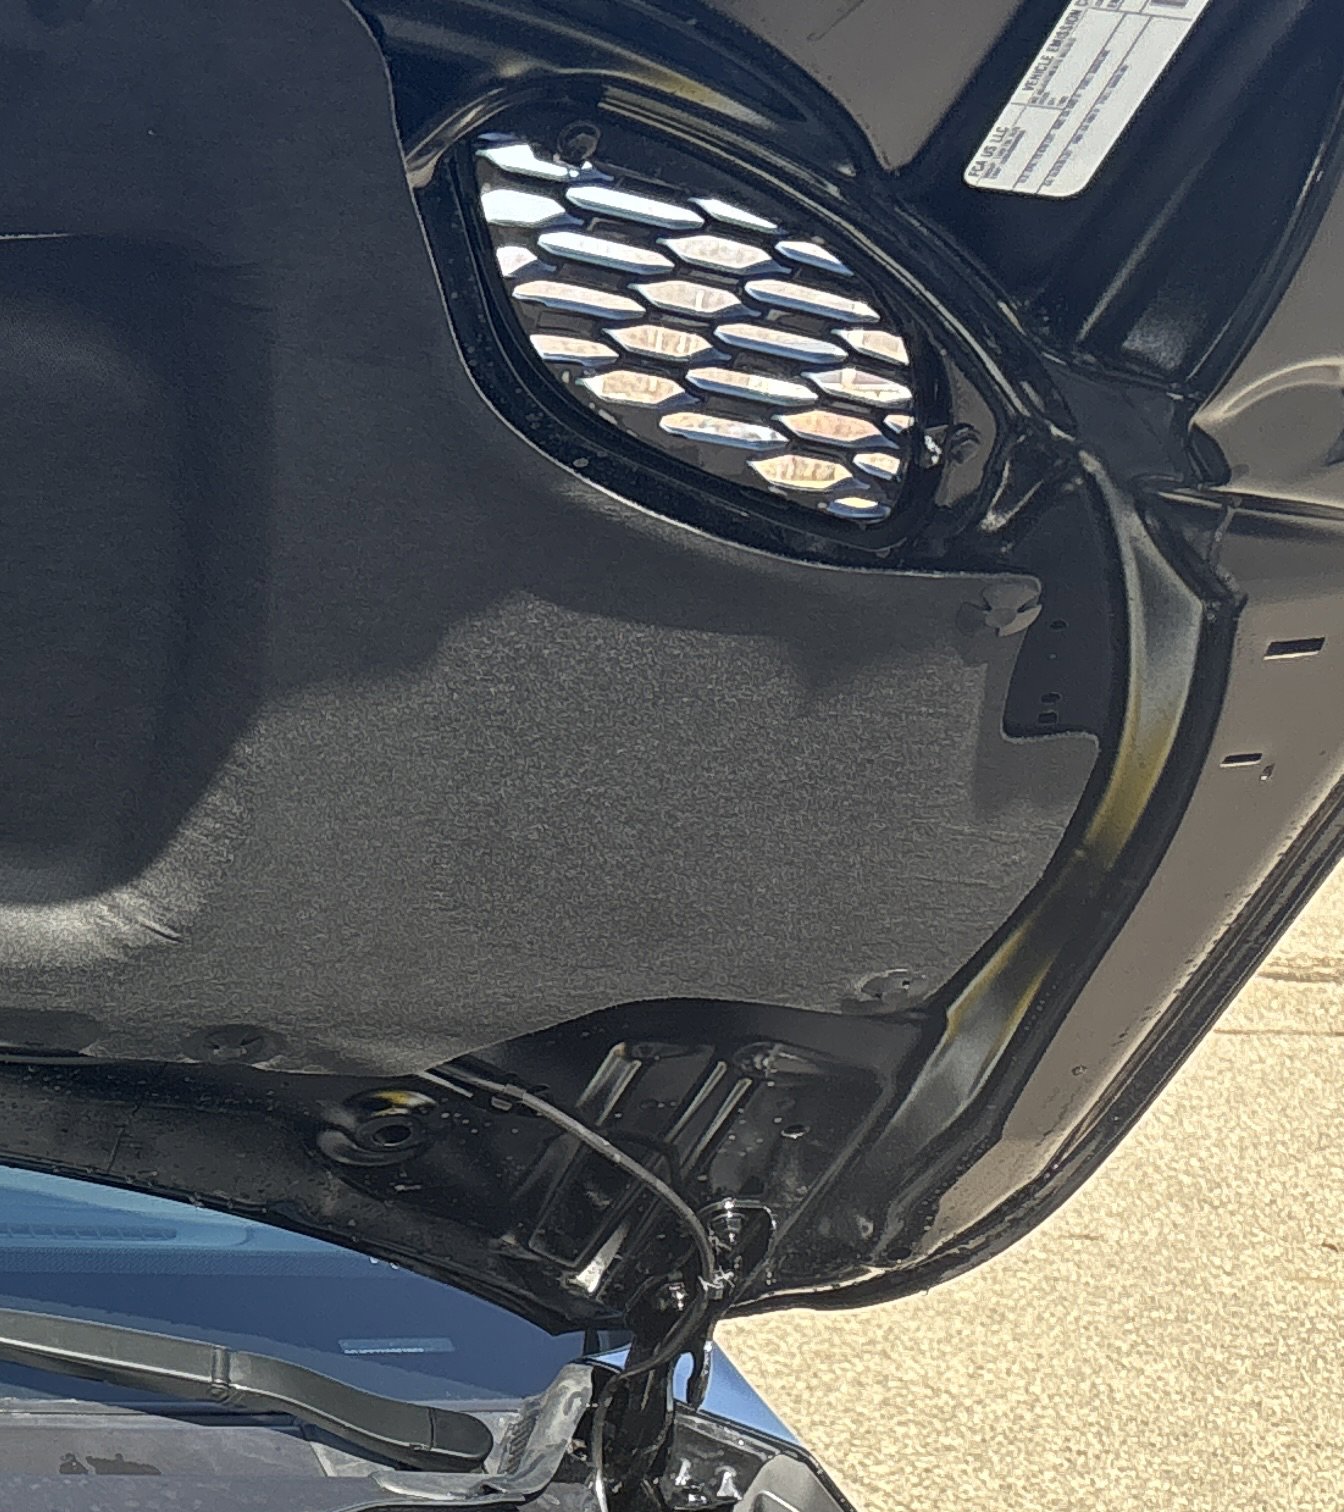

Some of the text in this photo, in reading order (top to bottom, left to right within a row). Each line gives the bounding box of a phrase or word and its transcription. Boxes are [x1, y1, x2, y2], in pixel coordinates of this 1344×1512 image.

[1022, 55, 1054, 91] VEHICLE
[1046, 9, 1083, 53] EMISSION
[968, 126, 1009, 177] FCA US LLC
